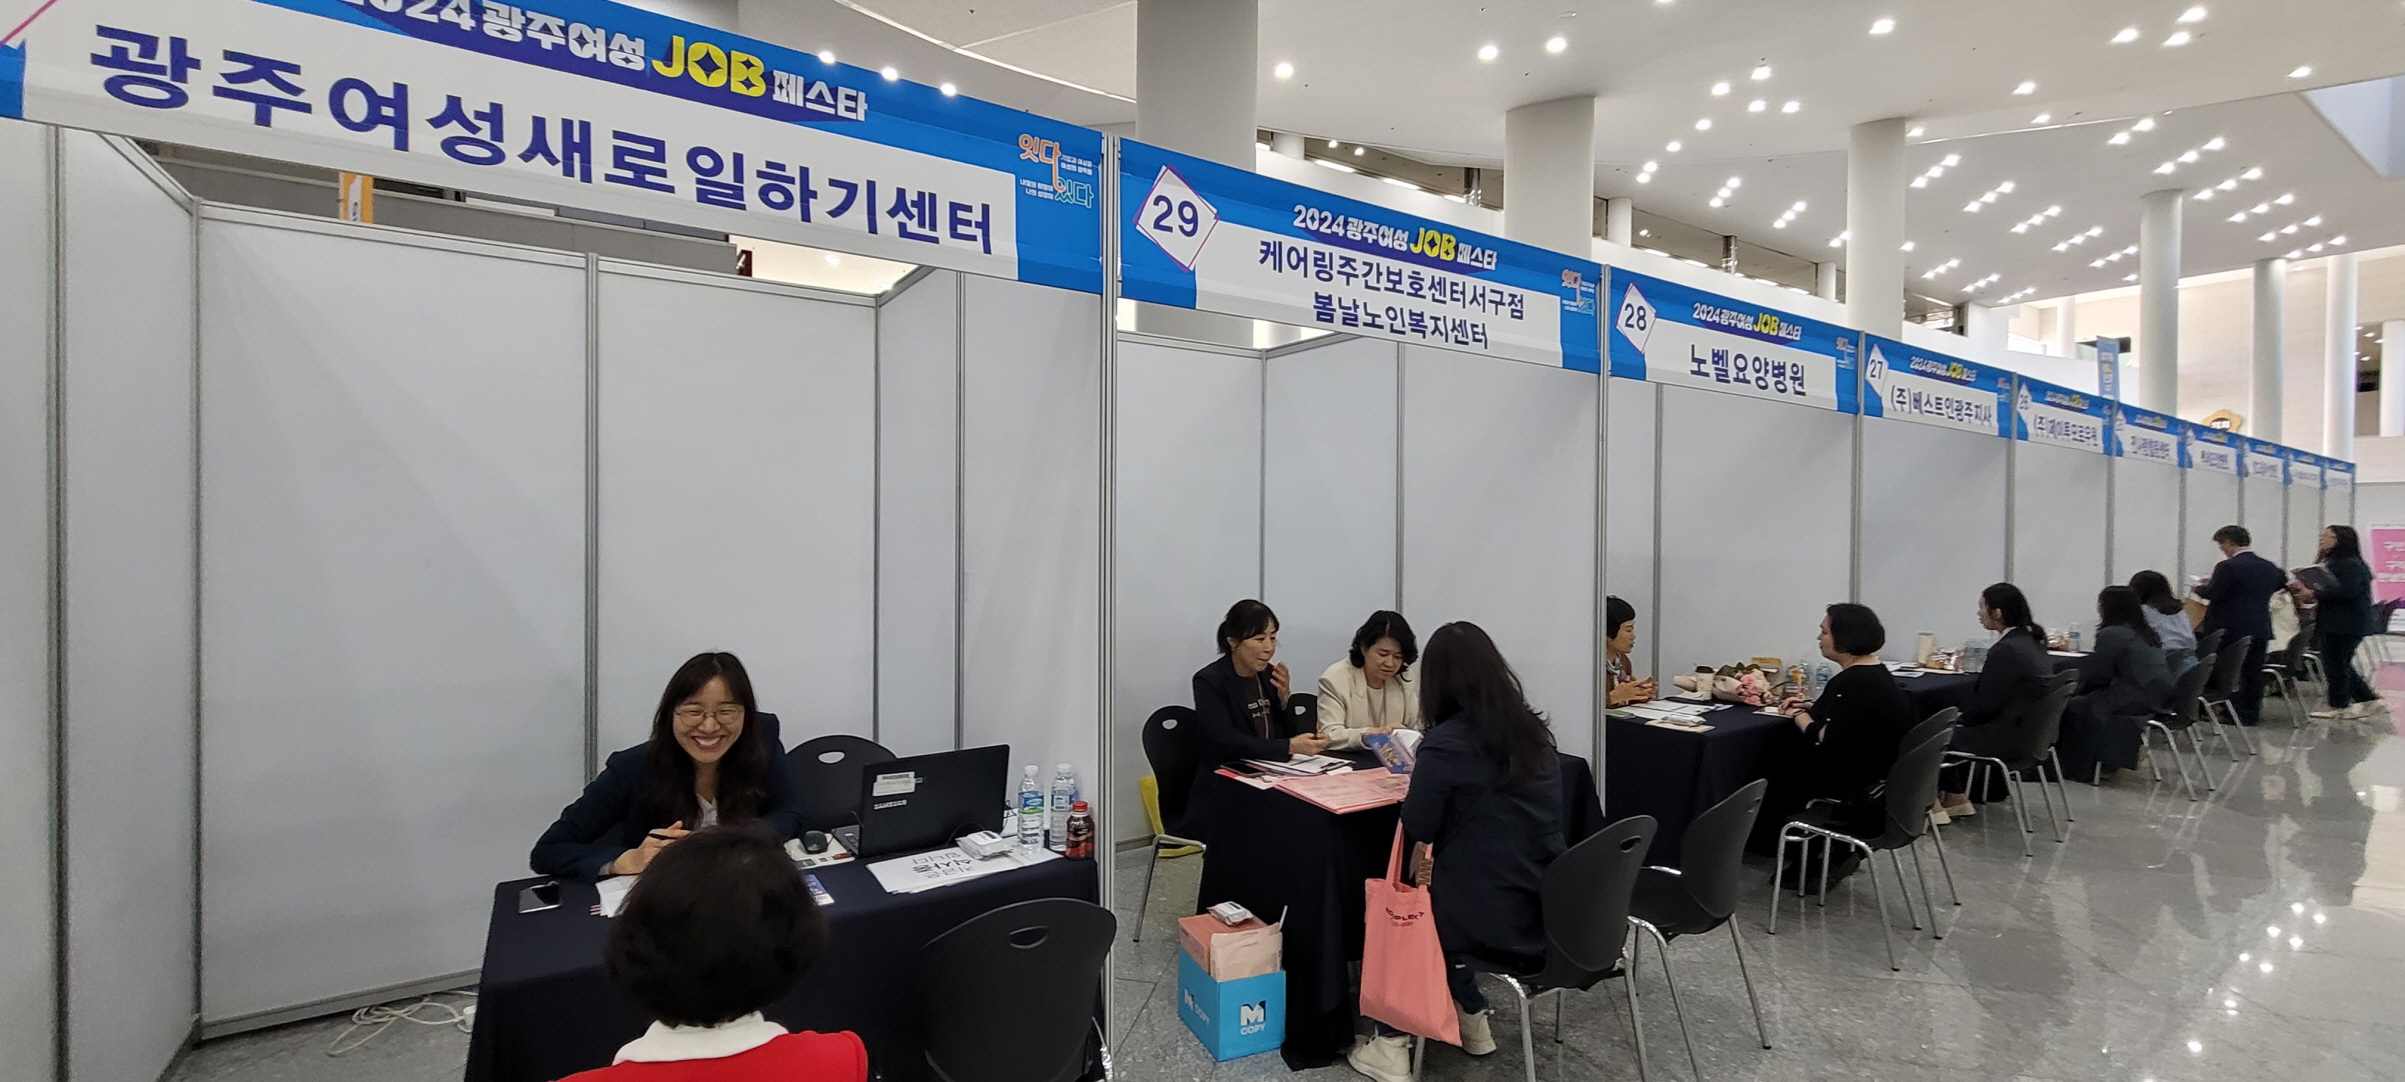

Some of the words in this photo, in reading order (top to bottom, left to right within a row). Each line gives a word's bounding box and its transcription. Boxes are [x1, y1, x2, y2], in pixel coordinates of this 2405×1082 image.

[482, 1, 646, 71] 광주여성
[651, 35, 767, 98] JOB
[772, 69, 868, 122] 페스타
[90, 24, 993, 256] 광주여성새로일하기센터
[1152, 194, 1199, 237] 29
[1409, 227, 1457, 261] JOB
[1456, 242, 1497, 271] 페스타
[1258, 238, 1525, 320] 케어링주간보호센터서구점
[1313, 291, 1489, 350] 봄날노인복지센터
[1623, 303, 1648, 332] 28
[1753, 313, 1780, 336] JOB
[1689, 344, 1807, 397] 노벨요양병원
[1869, 359, 1884, 379] 27
[912, 852, 961, 865] 입니다
[924, 866, 974, 879] 지금은
[1240, 1001, 1267, 1026] M
[1240, 1023, 1266, 1036] COPY
